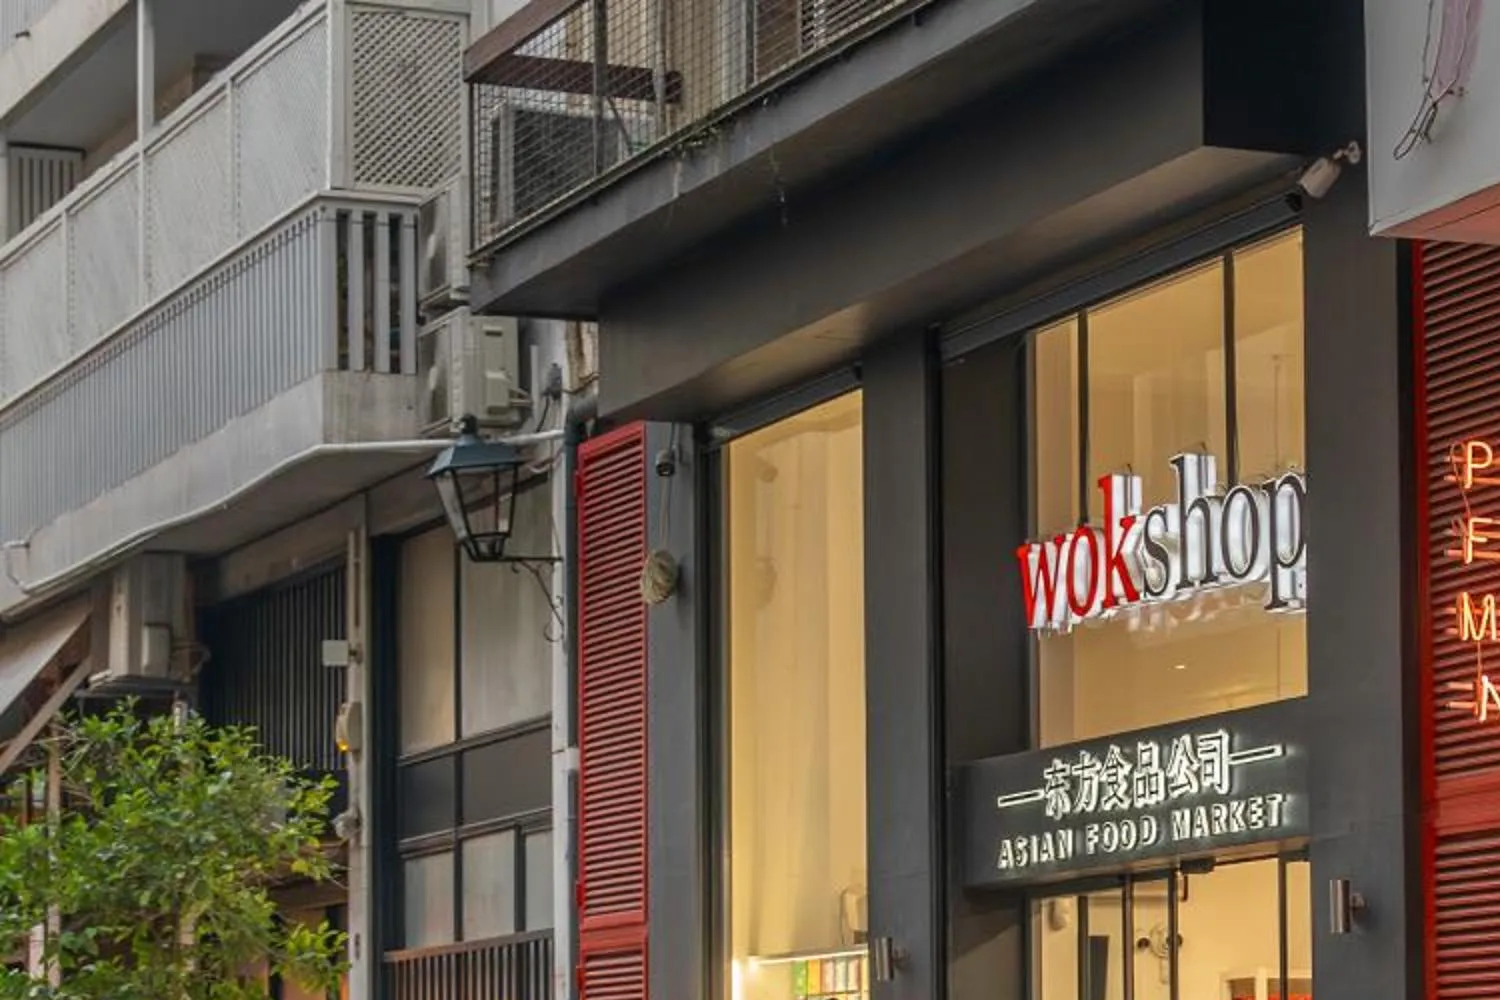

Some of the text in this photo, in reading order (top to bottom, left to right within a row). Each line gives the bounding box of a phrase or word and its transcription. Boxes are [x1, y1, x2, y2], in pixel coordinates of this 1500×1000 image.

[1015, 453, 1307, 630] wokshop
[1043, 728, 1231, 820] 东方食品公司
[997, 793, 1287, 870] ASIAN FOOD MARKET
